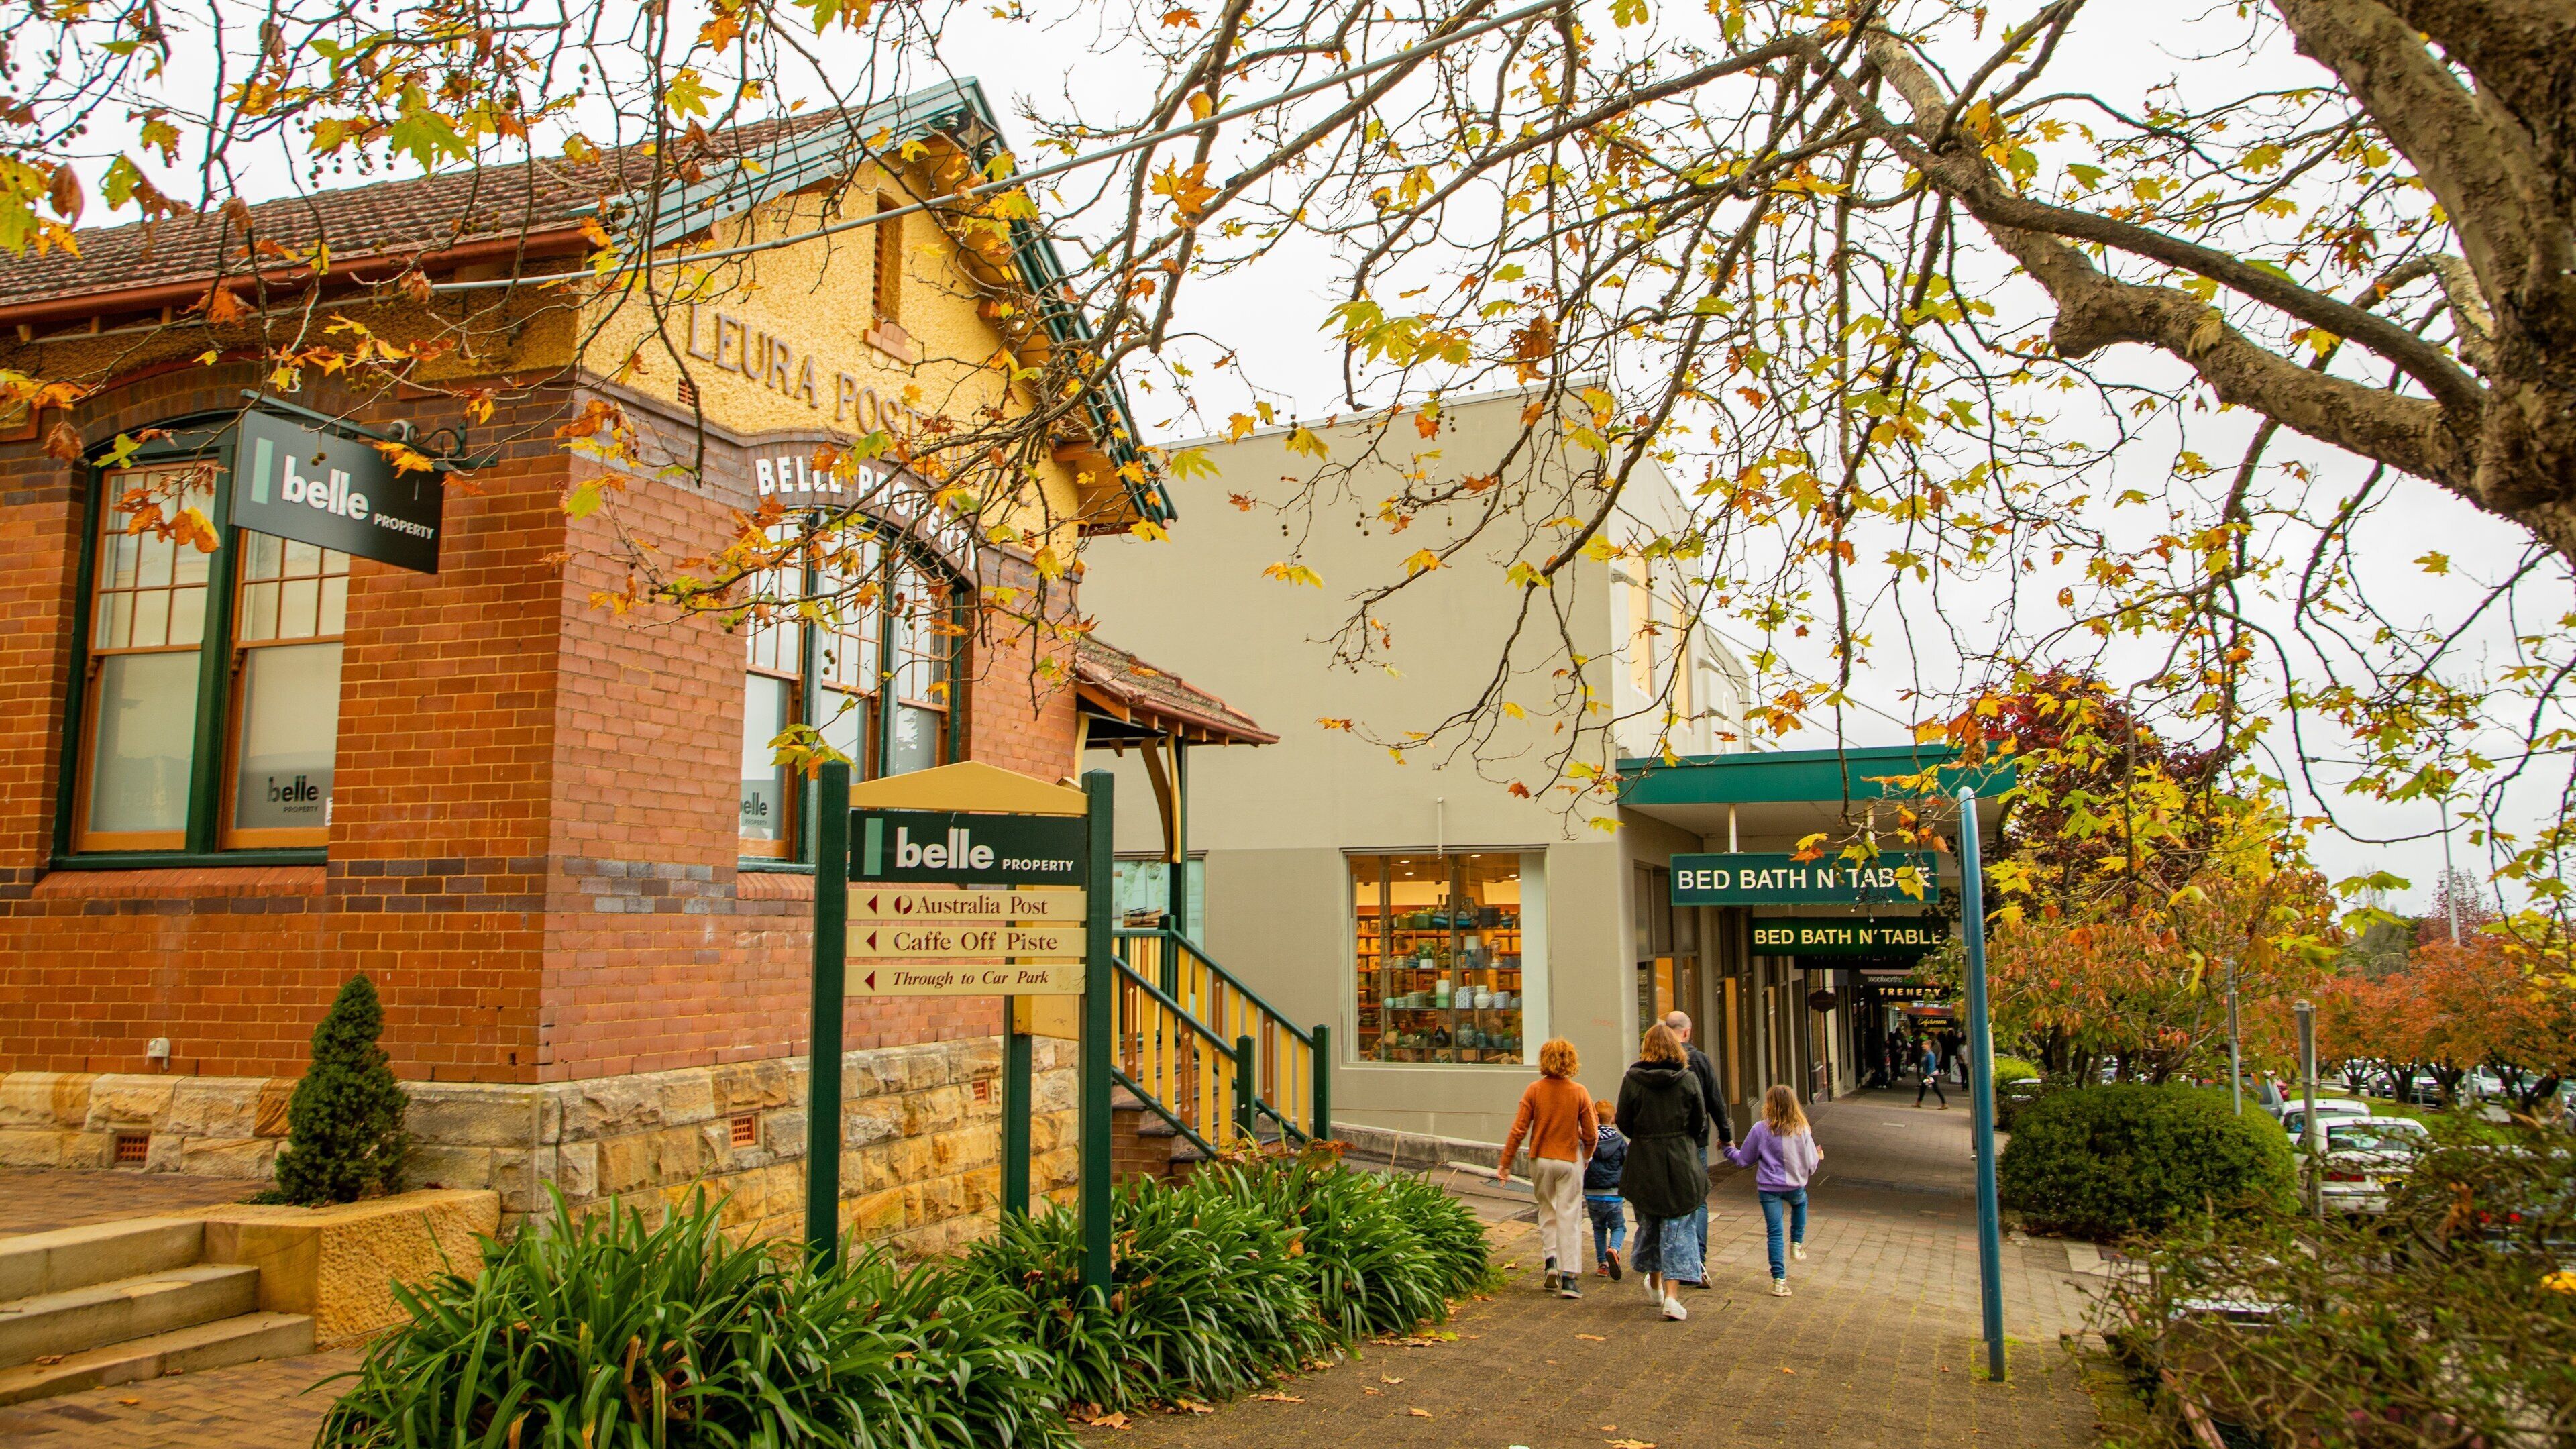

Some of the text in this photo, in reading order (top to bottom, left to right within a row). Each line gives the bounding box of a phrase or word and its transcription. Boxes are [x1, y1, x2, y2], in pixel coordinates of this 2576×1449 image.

[687, 302, 923, 455] LEURA POST
[755, 456, 843, 496] BELLE
[282, 455, 434, 539] belle PROPERTY
[268, 775, 319, 802] belle
[740, 792, 767, 815] elle
[896, 827, 1074, 871] belle PROPERTY
[1678, 867, 1929, 890] BED BATH N TAB
[916, 895, 1048, 914] Australia Post
[894, 932, 1057, 951] Caffe Off Piste
[1754, 930, 1794, 945] BED
[1801, 929, 1851, 945] BATH
[894, 971, 1049, 988] Through to Car Park
